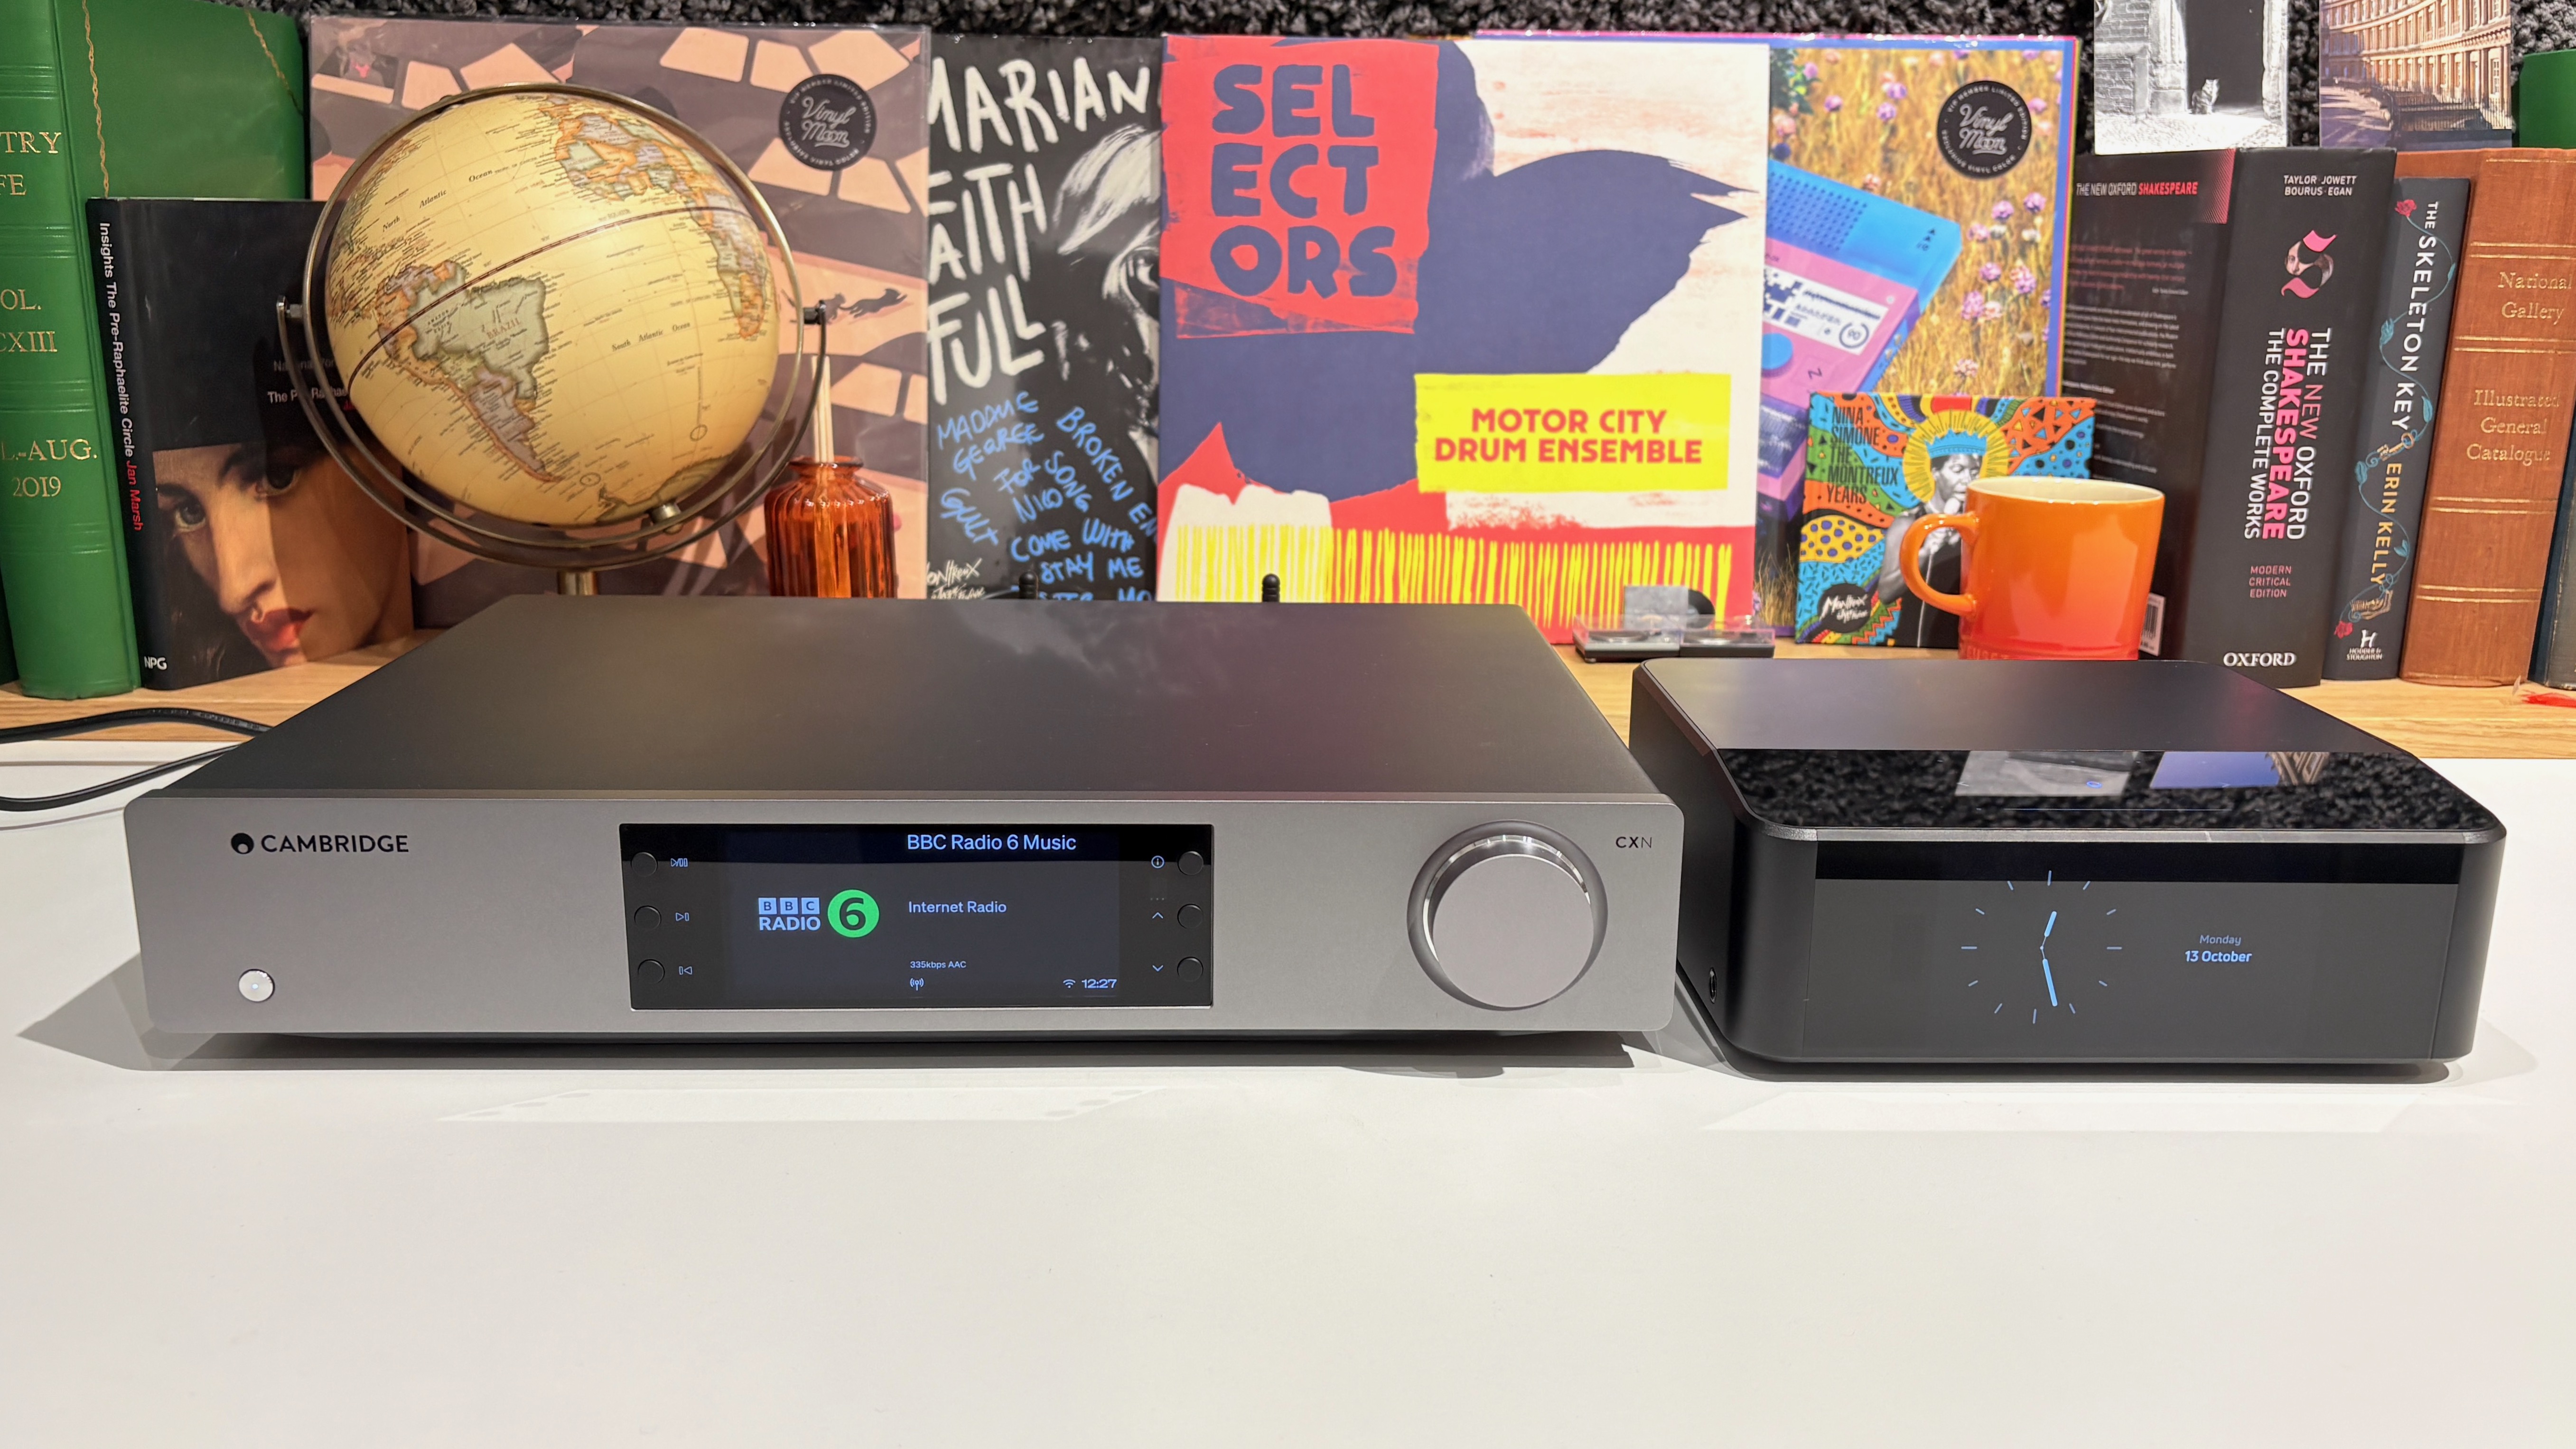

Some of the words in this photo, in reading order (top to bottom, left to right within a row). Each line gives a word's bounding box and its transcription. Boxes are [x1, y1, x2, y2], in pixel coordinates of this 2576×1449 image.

[802, 96, 856, 130] Vinyl
[1212, 64, 1374, 138] SEL
[1960, 103, 2014, 137] Vinyl
[0, 131, 62, 153] TRY
[801, 120, 850, 148] Moon
[1959, 127, 2007, 155] Moon
[1211, 142, 1379, 218] ECT
[2076, 182, 2090, 196] THE
[2091, 182, 2107, 196] NEW
[2108, 182, 2137, 196] OXFORD
[2138, 181, 2199, 196] SHAKESPEARE
[2283, 175, 2317, 185] TAYLOR
[2321, 175, 2357, 186] JOWETT
[2284, 187, 2323, 196] BOURUS
[2328, 187, 2352, 196] EGAN
[382, 215, 401, 233] North
[419, 190, 447, 209] Atlantic
[469, 169, 493, 183] Ocean
[2424, 201, 2438, 229] THE
[99, 223, 113, 279] Insights
[1210, 225, 1397, 299] ORS
[2498, 271, 2573, 289] National
[106, 282, 117, 309] The
[2400, 235, 2437, 372] SKELETON
[2501, 301, 2564, 325] Gallery
[486, 317, 522, 340] BRAZIL
[638, 329, 663, 343] Atlantic
[672, 322, 691, 332] Ocean
[928, 274, 1046, 405] FULL
[2265, 327, 2286, 365] THE
[2307, 327, 2332, 376] THE
[109, 312, 130, 414] Pre-Raphaelite
[2299, 383, 2324, 439] NEW
[2391, 382, 2416, 431] KEY
[2473, 389, 2561, 408] Illustrated
[1472, 408, 1588, 434] MOTOR
[1599, 409, 1667, 434] CITY
[1831, 407, 1864, 426] NINA
[2252, 370, 2279, 470] COMPLETE
[2480, 417, 2548, 435] General
[121, 418, 135, 458] Circle
[1831, 426, 1880, 446] SIMONE
[2262, 328, 2309, 539] SHAKESPEARE
[952, 422, 1045, 481] GEORGE
[1056, 405, 1135, 502] BROKEN
[1434, 437, 1527, 462] DRUM
[1538, 438, 1702, 464] ENSEMBLE
[1829, 446, 1851, 465] THE
[2466, 443, 2551, 467] Catalogue
[126, 460, 137, 485] Jan
[992, 458, 1042, 495] FOR
[1044, 450, 1092, 513] SONG
[1828, 466, 1899, 486] MONTREUX
[12, 476, 62, 497] 2019
[1827, 485, 1867, 505] YEARS
[2286, 446, 2317, 540] OXFORD
[2381, 463, 2402, 514] ERIN
[129, 489, 144, 531] Marsh
[2244, 473, 2267, 540] WORKS
[1082, 517, 1135, 553] WITH
[2370, 521, 2393, 586] KELLY
[1040, 551, 1094, 584] STAY
[1107, 556, 1144, 580] ME
[2250, 565, 2292, 575] MODERN
[2249, 577, 2291, 587] CRITICAL
[2249, 589, 2287, 598] EDITION
[144, 655, 167, 670] NPG
[2223, 652, 2297, 667] OXFORD
[261, 834, 409, 852] CAMBRIDGE
[907, 834, 946, 850] BBC
[952, 834, 1003, 850] Radio
[1007, 834, 1019, 850] 6
[1023, 834, 1077, 850] Music
[1615, 836, 1652, 849] CXN
[759, 916, 821, 931] RADIO
[840, 897, 866, 931] 6
[761, 899, 817, 913] BBC
[908, 901, 964, 913] Internet
[967, 901, 1007, 913] Radio
[2200, 935, 2241, 946] Monday
[910, 961, 946, 970] 335kbps
[948, 961, 967, 969] AAC
[2185, 950, 2199, 962] 13
[2202, 950, 2253, 962] October
[1082, 978, 1118, 989] 12:27
